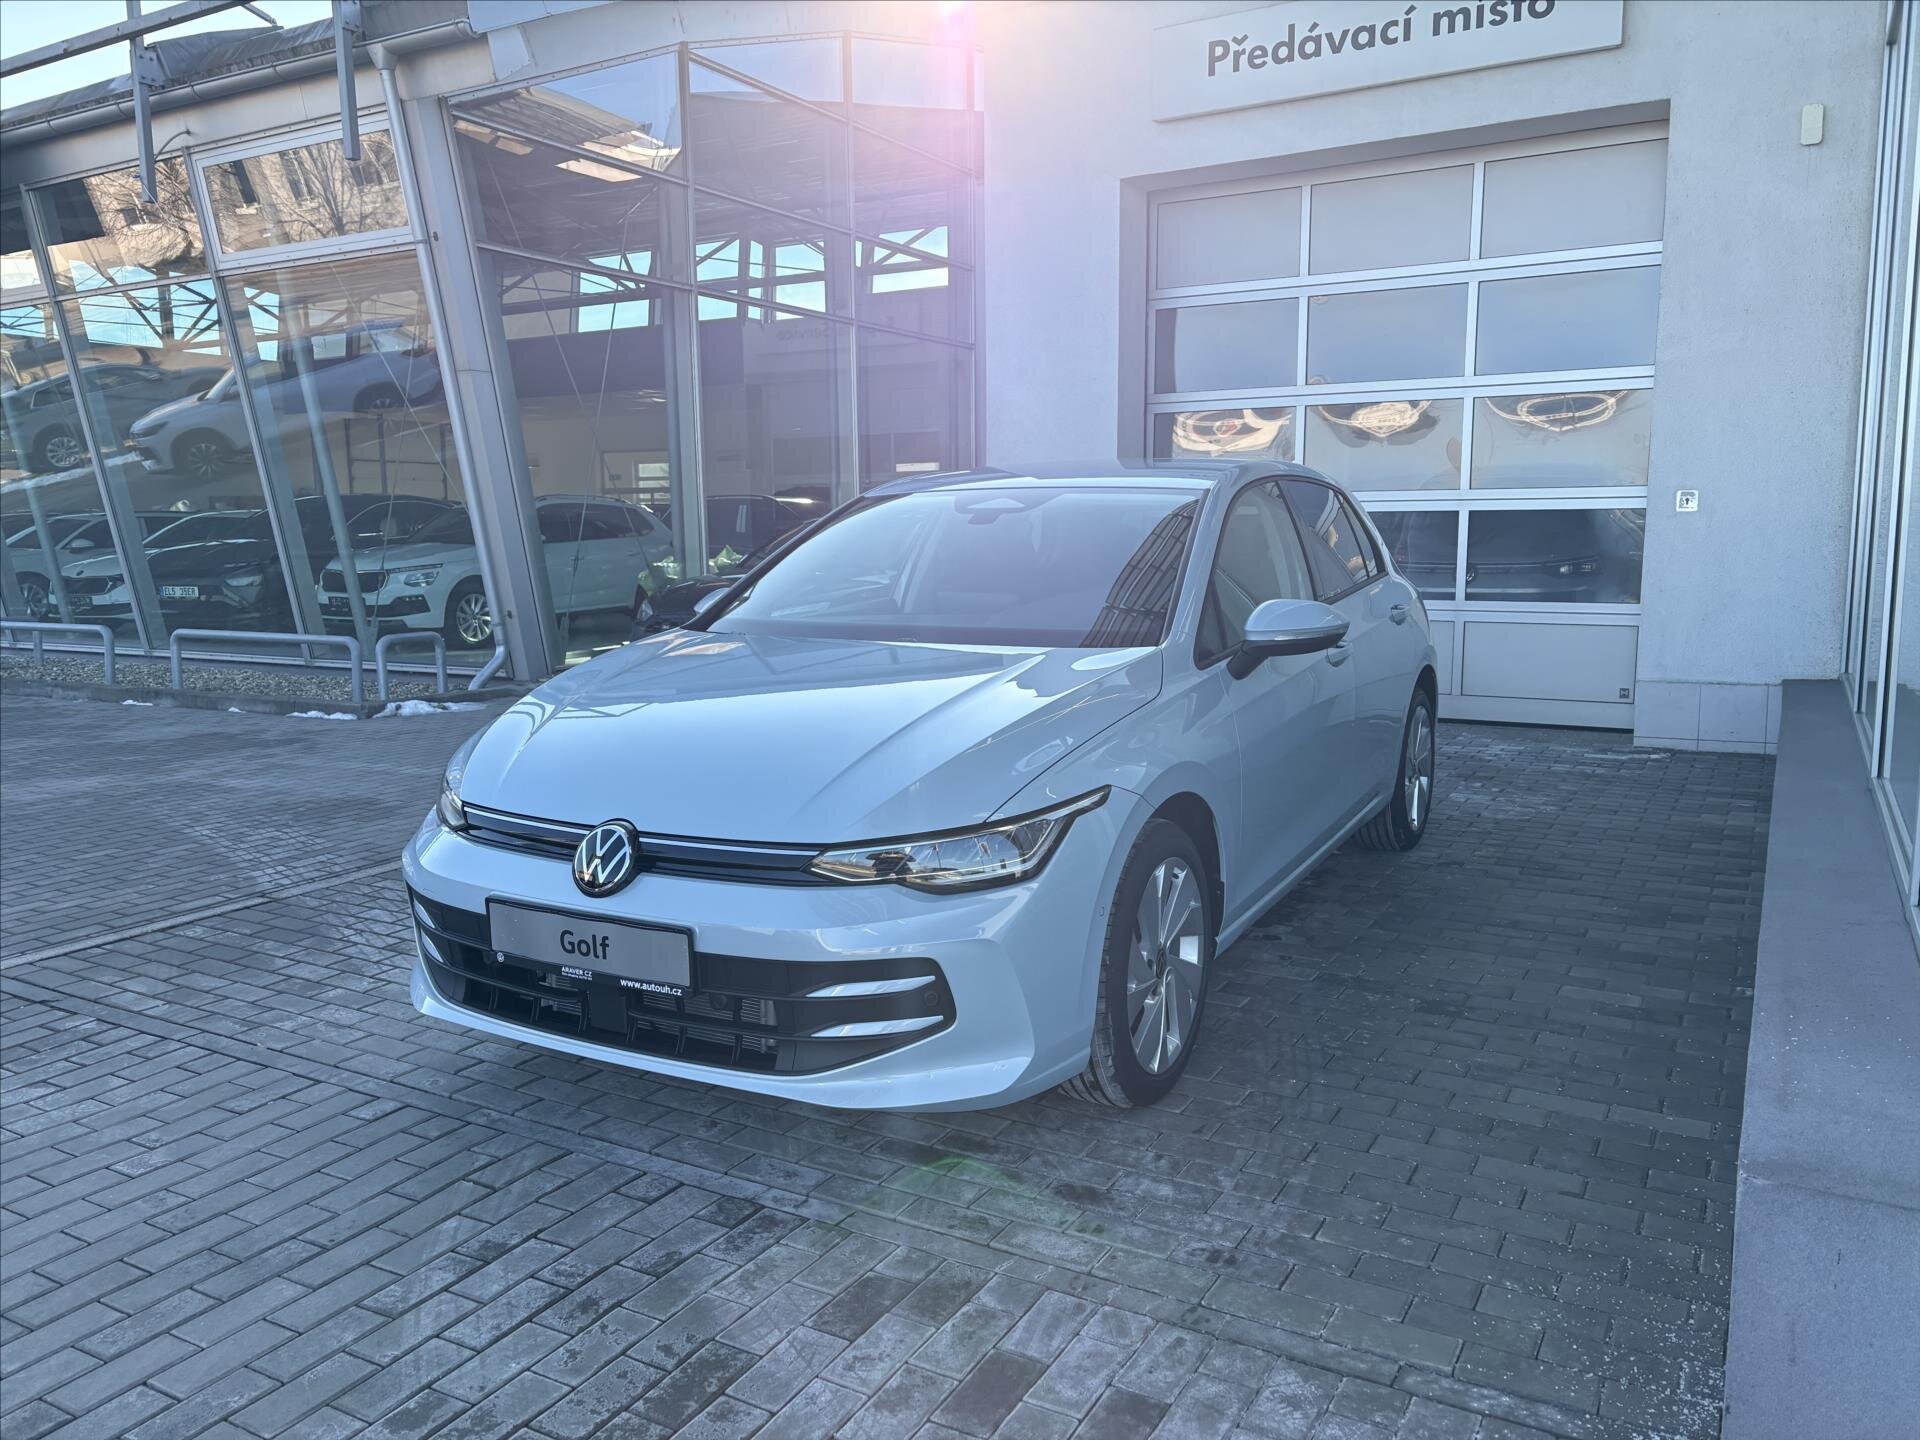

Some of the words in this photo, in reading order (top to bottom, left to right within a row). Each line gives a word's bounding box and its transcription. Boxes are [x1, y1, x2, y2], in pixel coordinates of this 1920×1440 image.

[1207, 4, 1417, 77] Předávací
[559, 929, 610, 960] Golf
[584, 970, 593, 978] CZ
[620, 978, 683, 997] www.autouh.cz
